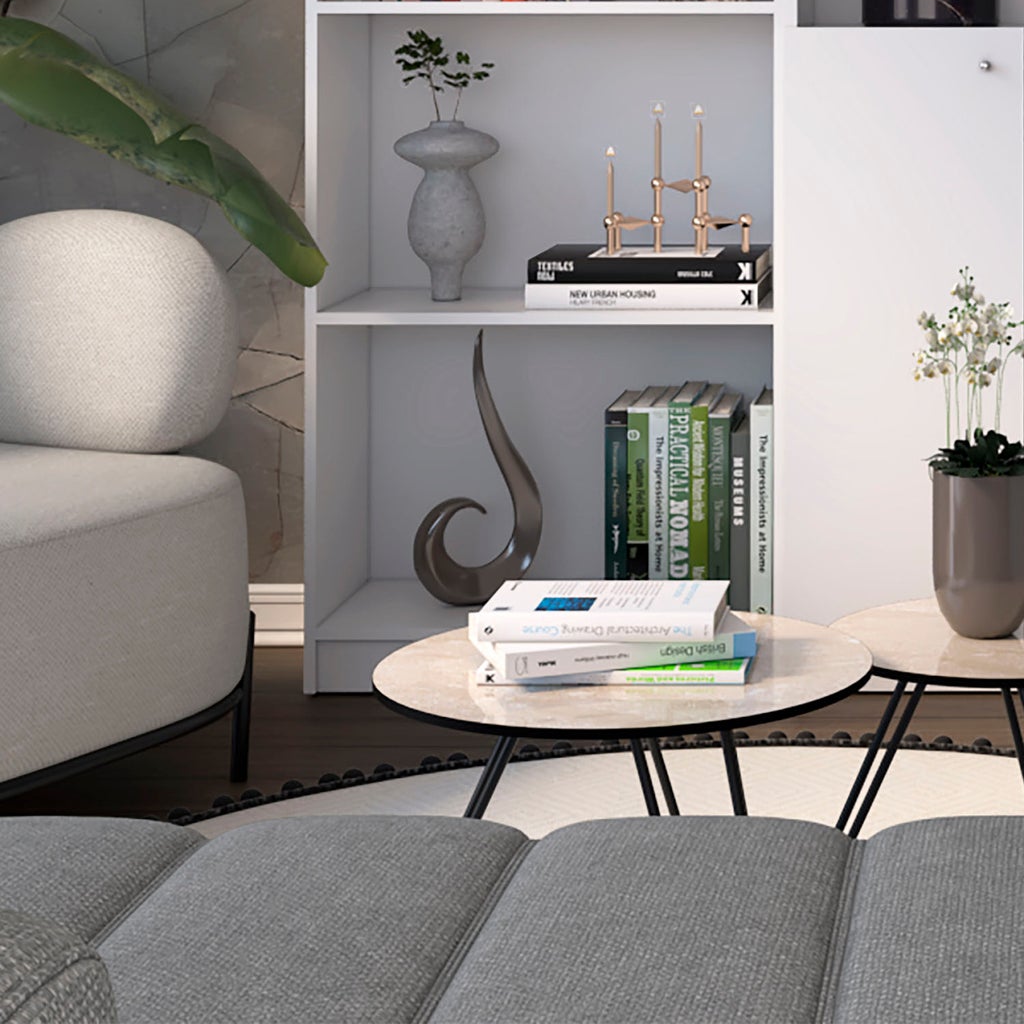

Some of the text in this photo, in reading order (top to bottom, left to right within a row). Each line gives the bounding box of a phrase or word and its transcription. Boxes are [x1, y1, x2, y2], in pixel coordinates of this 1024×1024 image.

[570, 290, 656, 298] NEW URBAN HOUSING
[654, 436, 664, 572] The Impressionists at Home
[669, 414, 689, 578] PRACTICAL NOMAD
[733, 457, 744, 526] MUSEUMS
[758, 436, 768, 573] The Impressionists at Home
[522, 625, 692, 636] The Architectural Drawing Course
[660, 642, 726, 657] British Design
